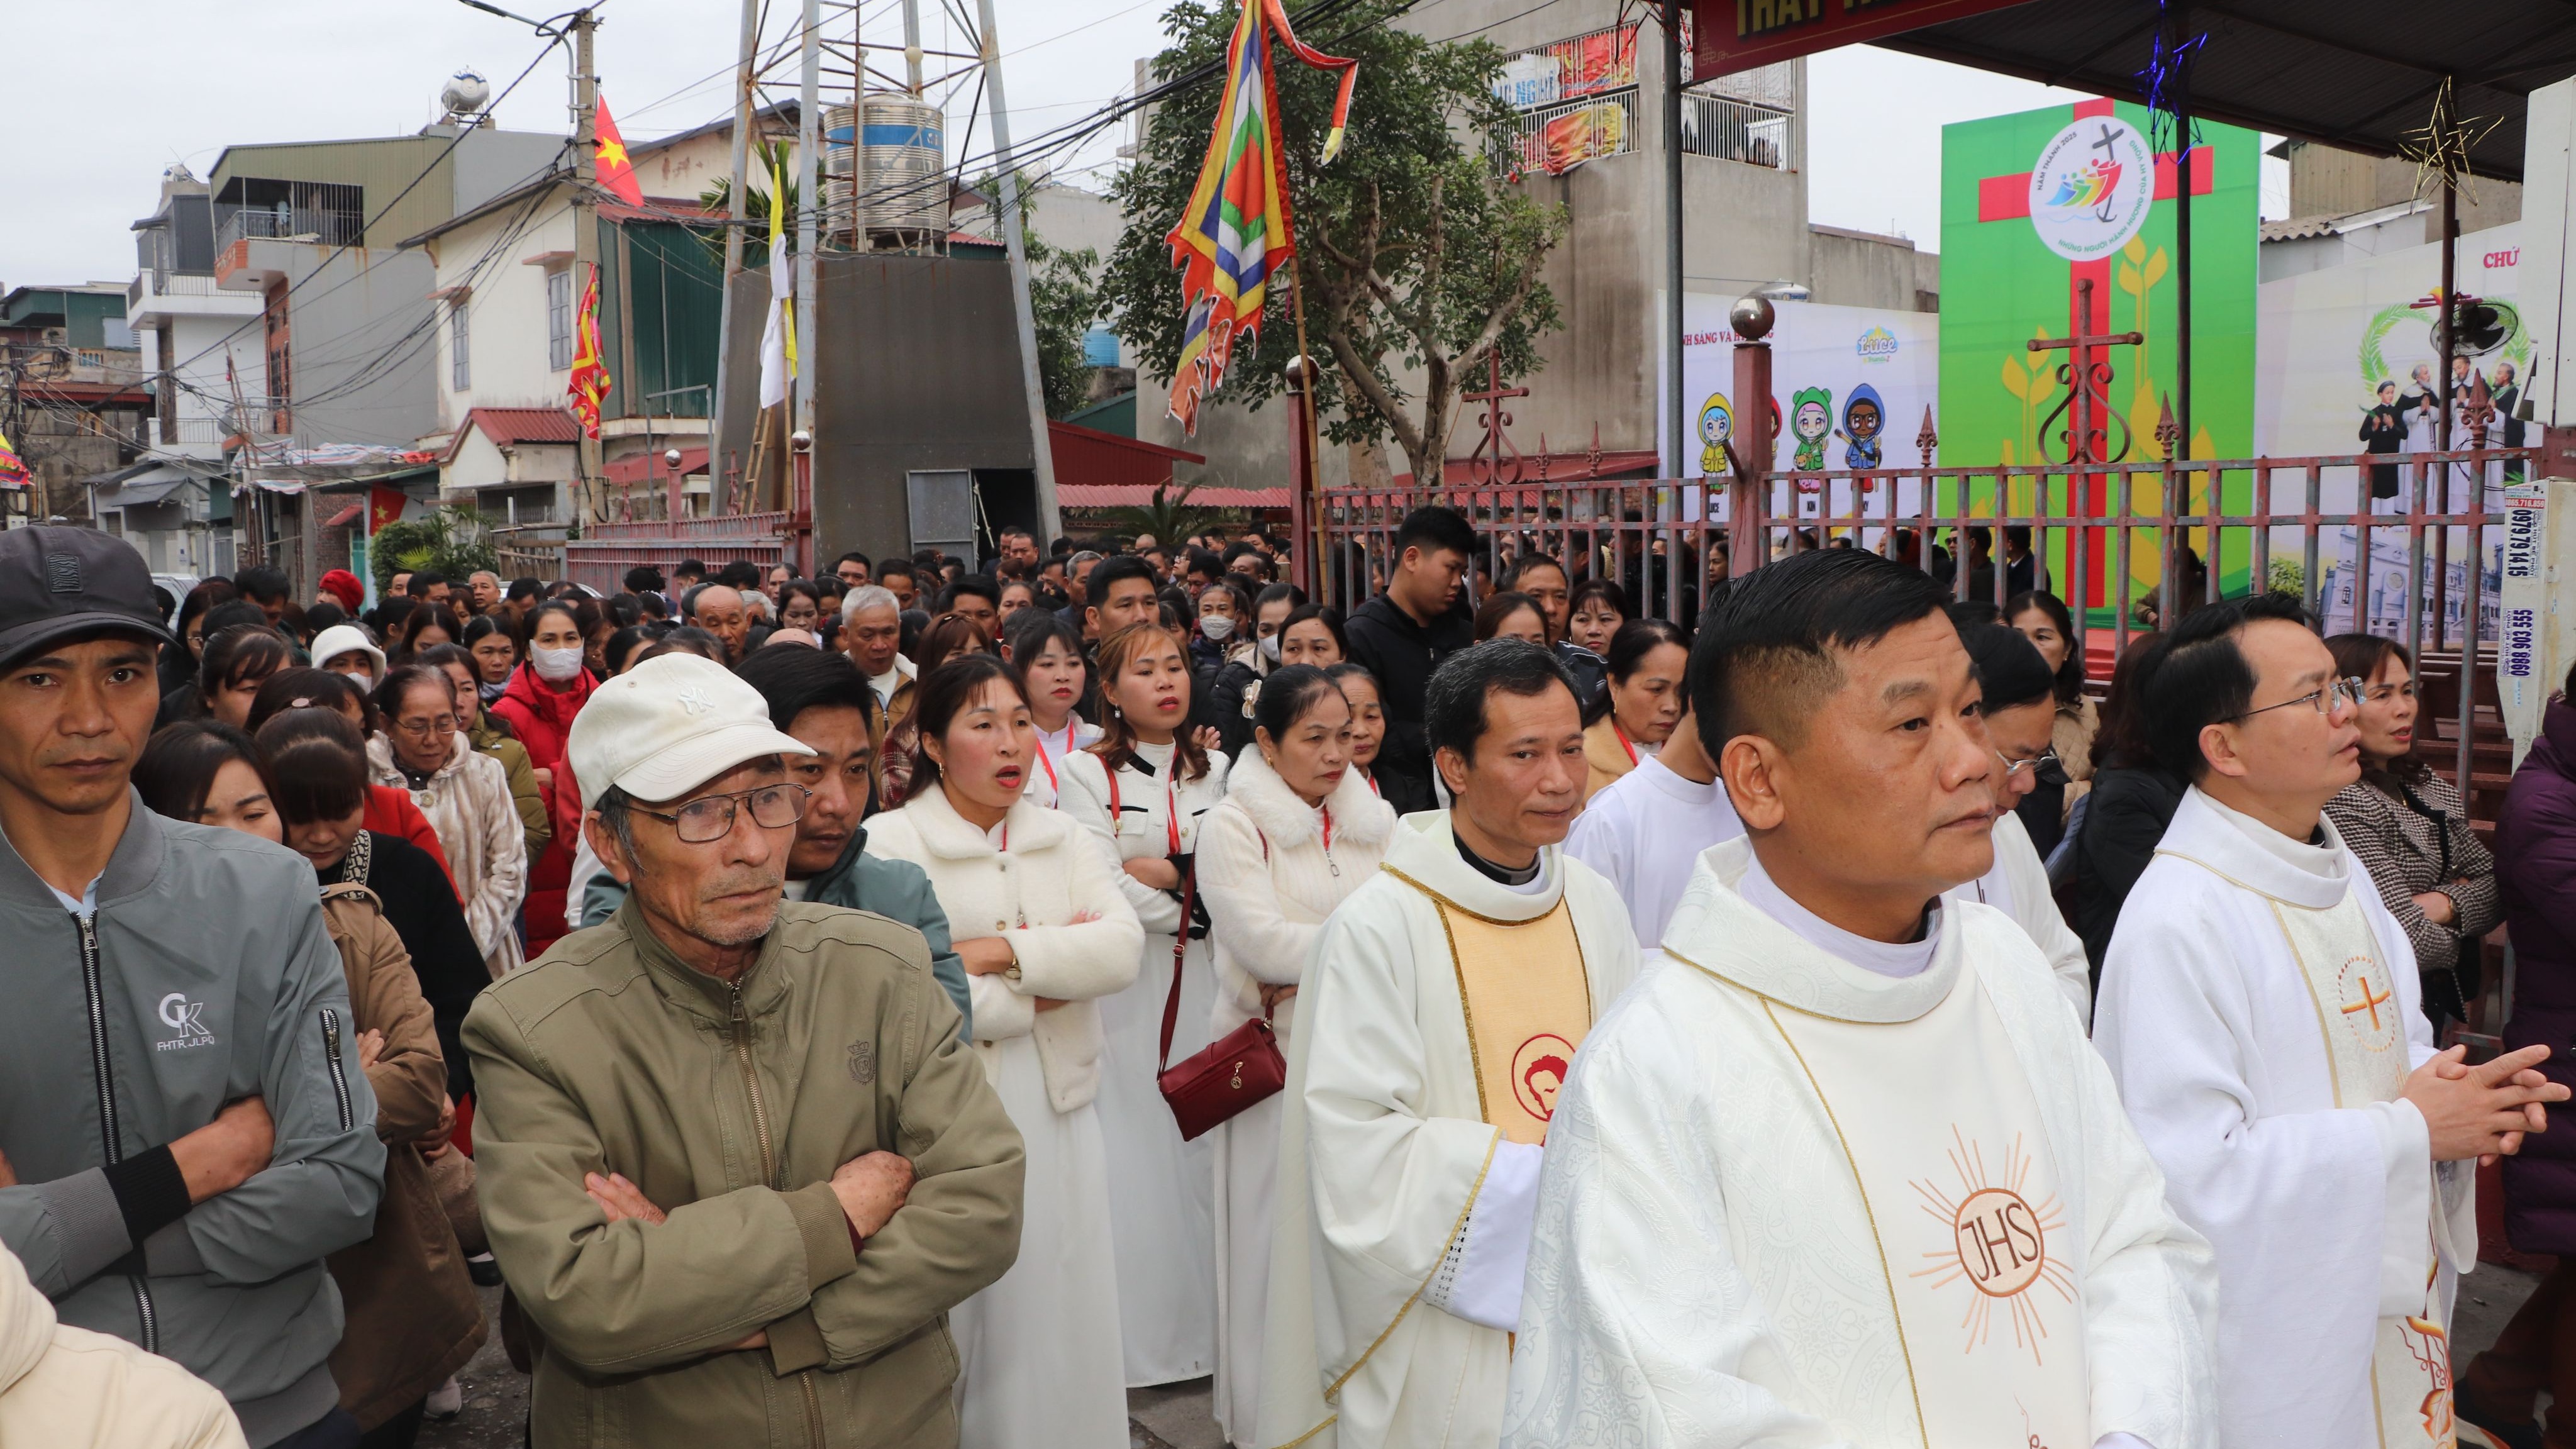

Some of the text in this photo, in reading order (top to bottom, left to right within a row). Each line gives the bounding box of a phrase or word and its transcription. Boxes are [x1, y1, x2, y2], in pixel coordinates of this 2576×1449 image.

[2043, 145, 2061, 170] THÁNH
[2060, 131, 2077, 147] 2025
[1694, 330, 1717, 345] SÁNG
[1719, 328, 1731, 343] VÀ
[1857, 335, 1897, 355] Luce
[2507, 509, 2532, 577] 0979.79.14.15
[2510, 609, 2533, 676] 0988.903.555
